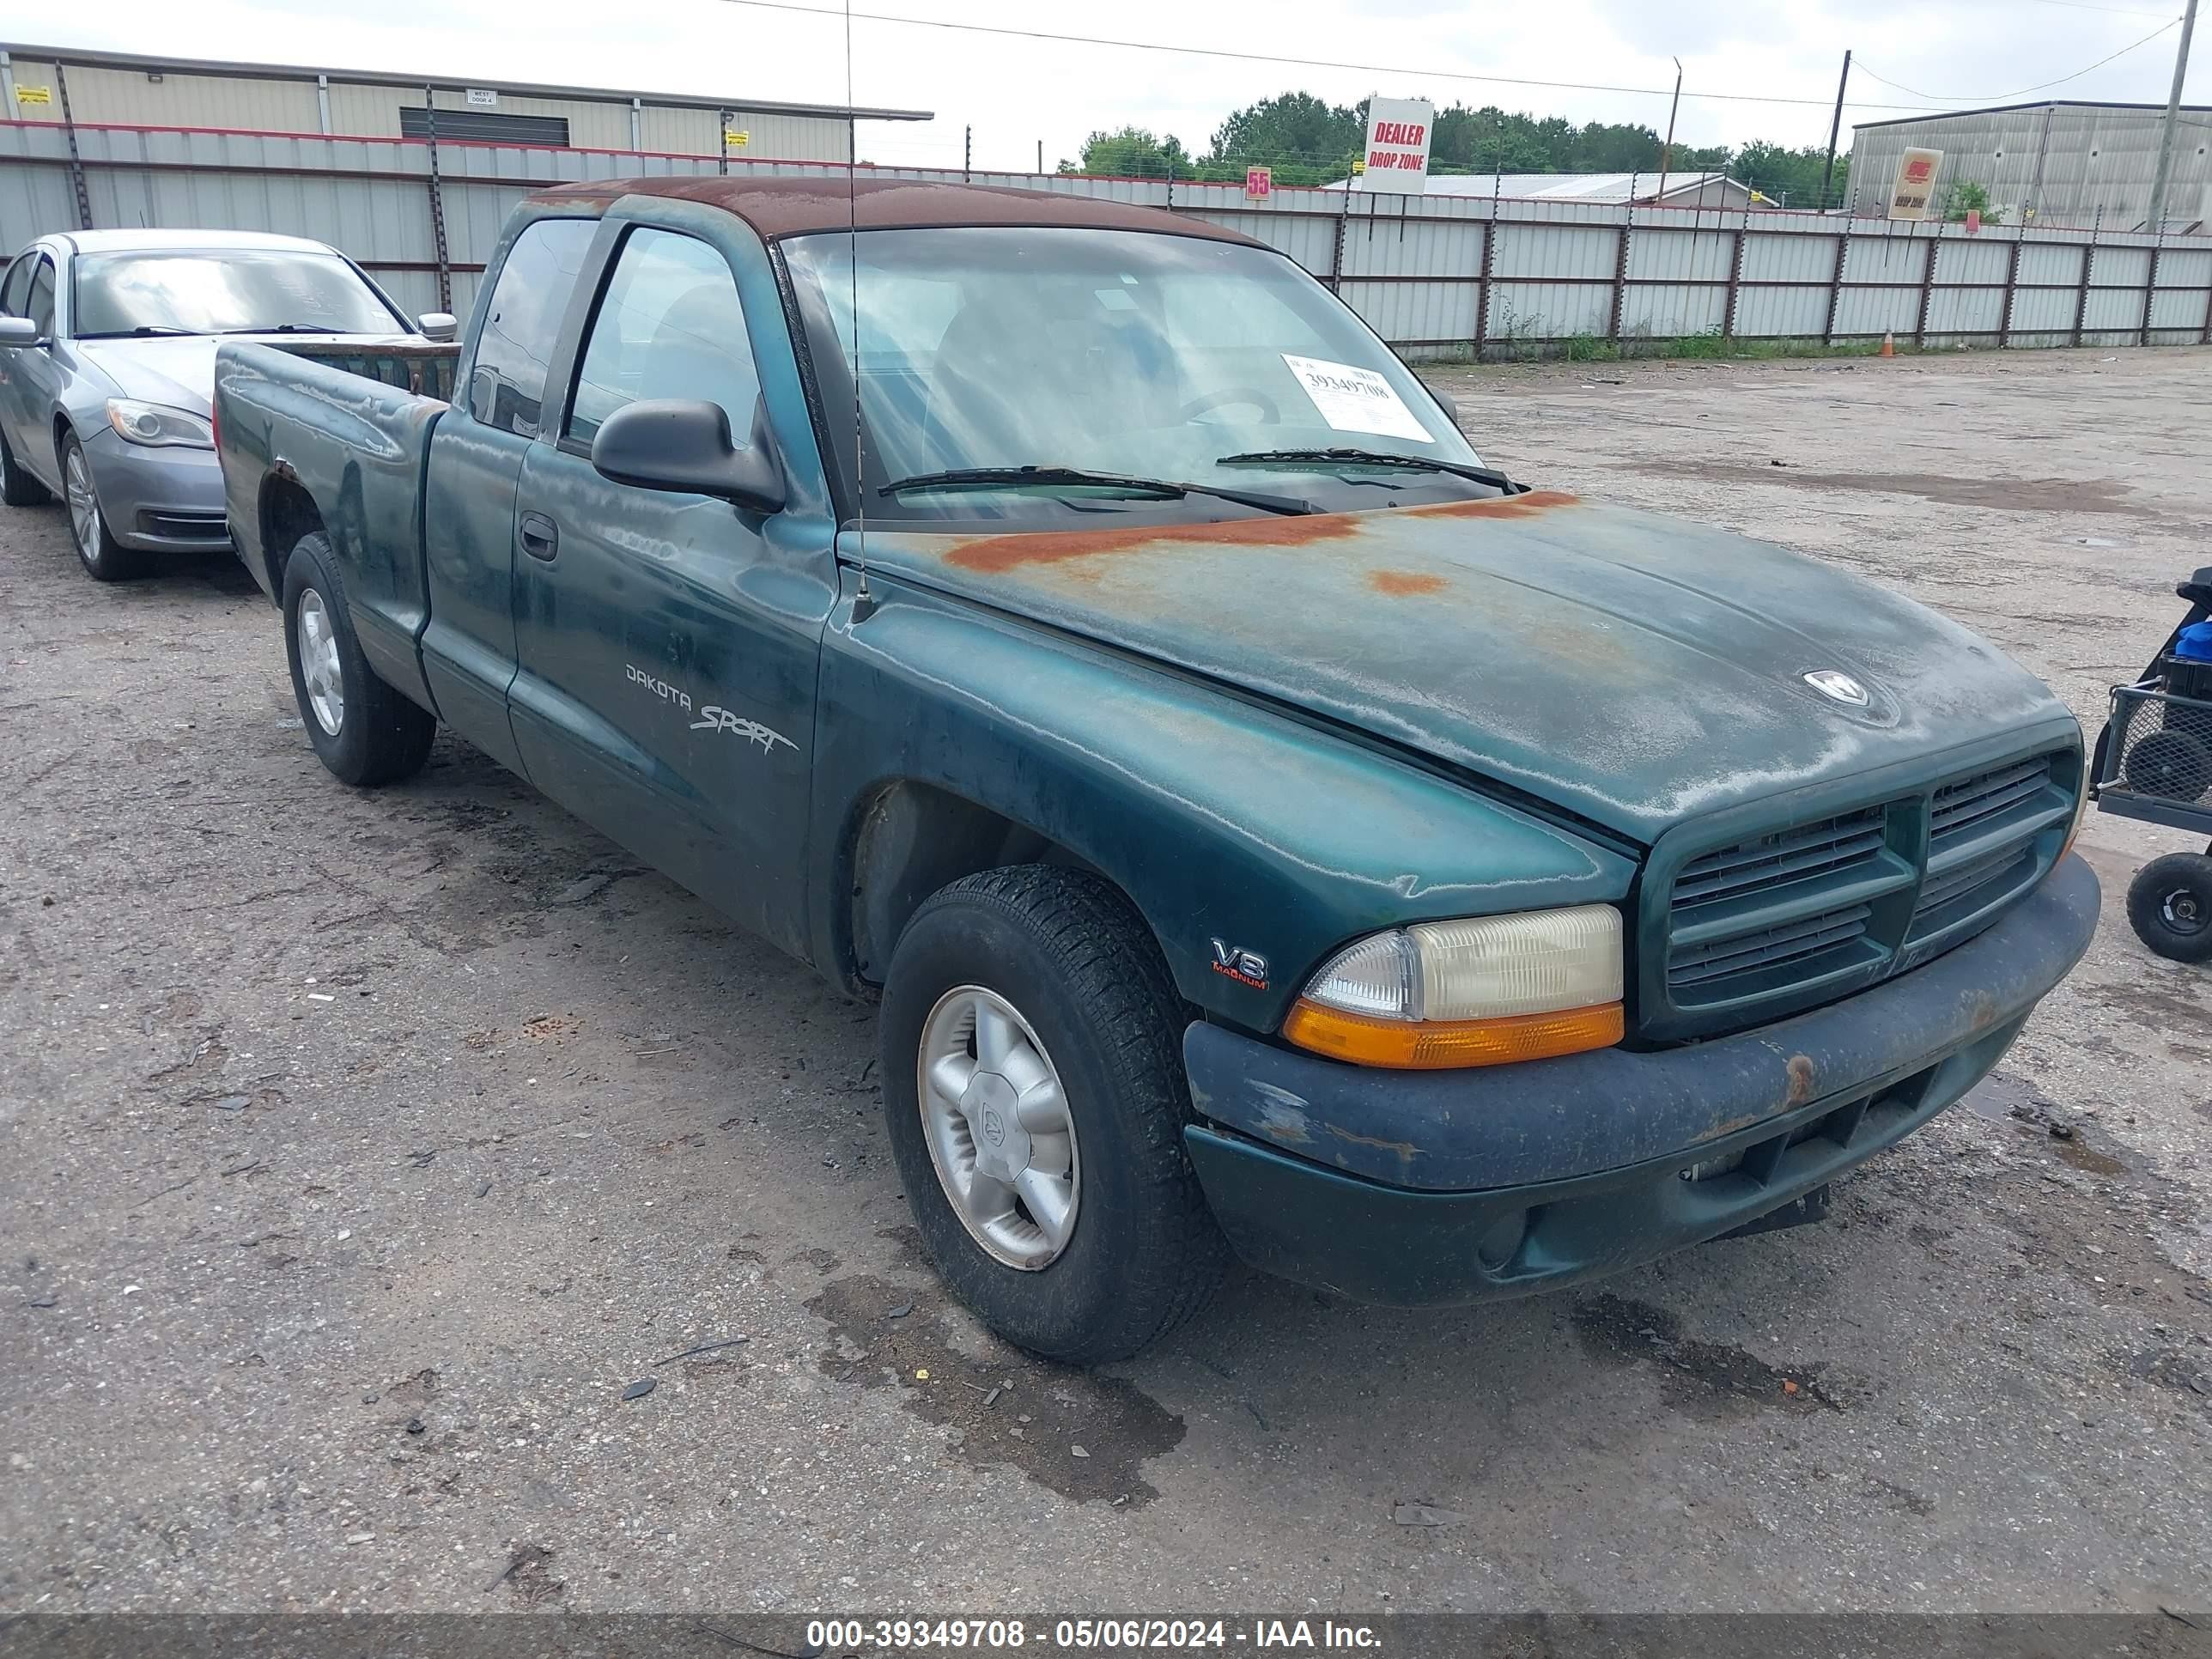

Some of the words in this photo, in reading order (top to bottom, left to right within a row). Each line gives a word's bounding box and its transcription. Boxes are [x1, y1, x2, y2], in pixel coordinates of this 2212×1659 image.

[1374, 122, 1425, 146] DEALER
[1369, 150, 1398, 169] DROP
[1397, 153, 1424, 171] ZONE
[1249, 172, 1268, 195] 55
[1305, 373, 1389, 399] 39349708
[626, 663, 692, 712] DAKOTA
[690, 705, 800, 756] SPORT
[1210, 937, 1268, 980] V8
[1212, 961, 1267, 990] MAGNUM
